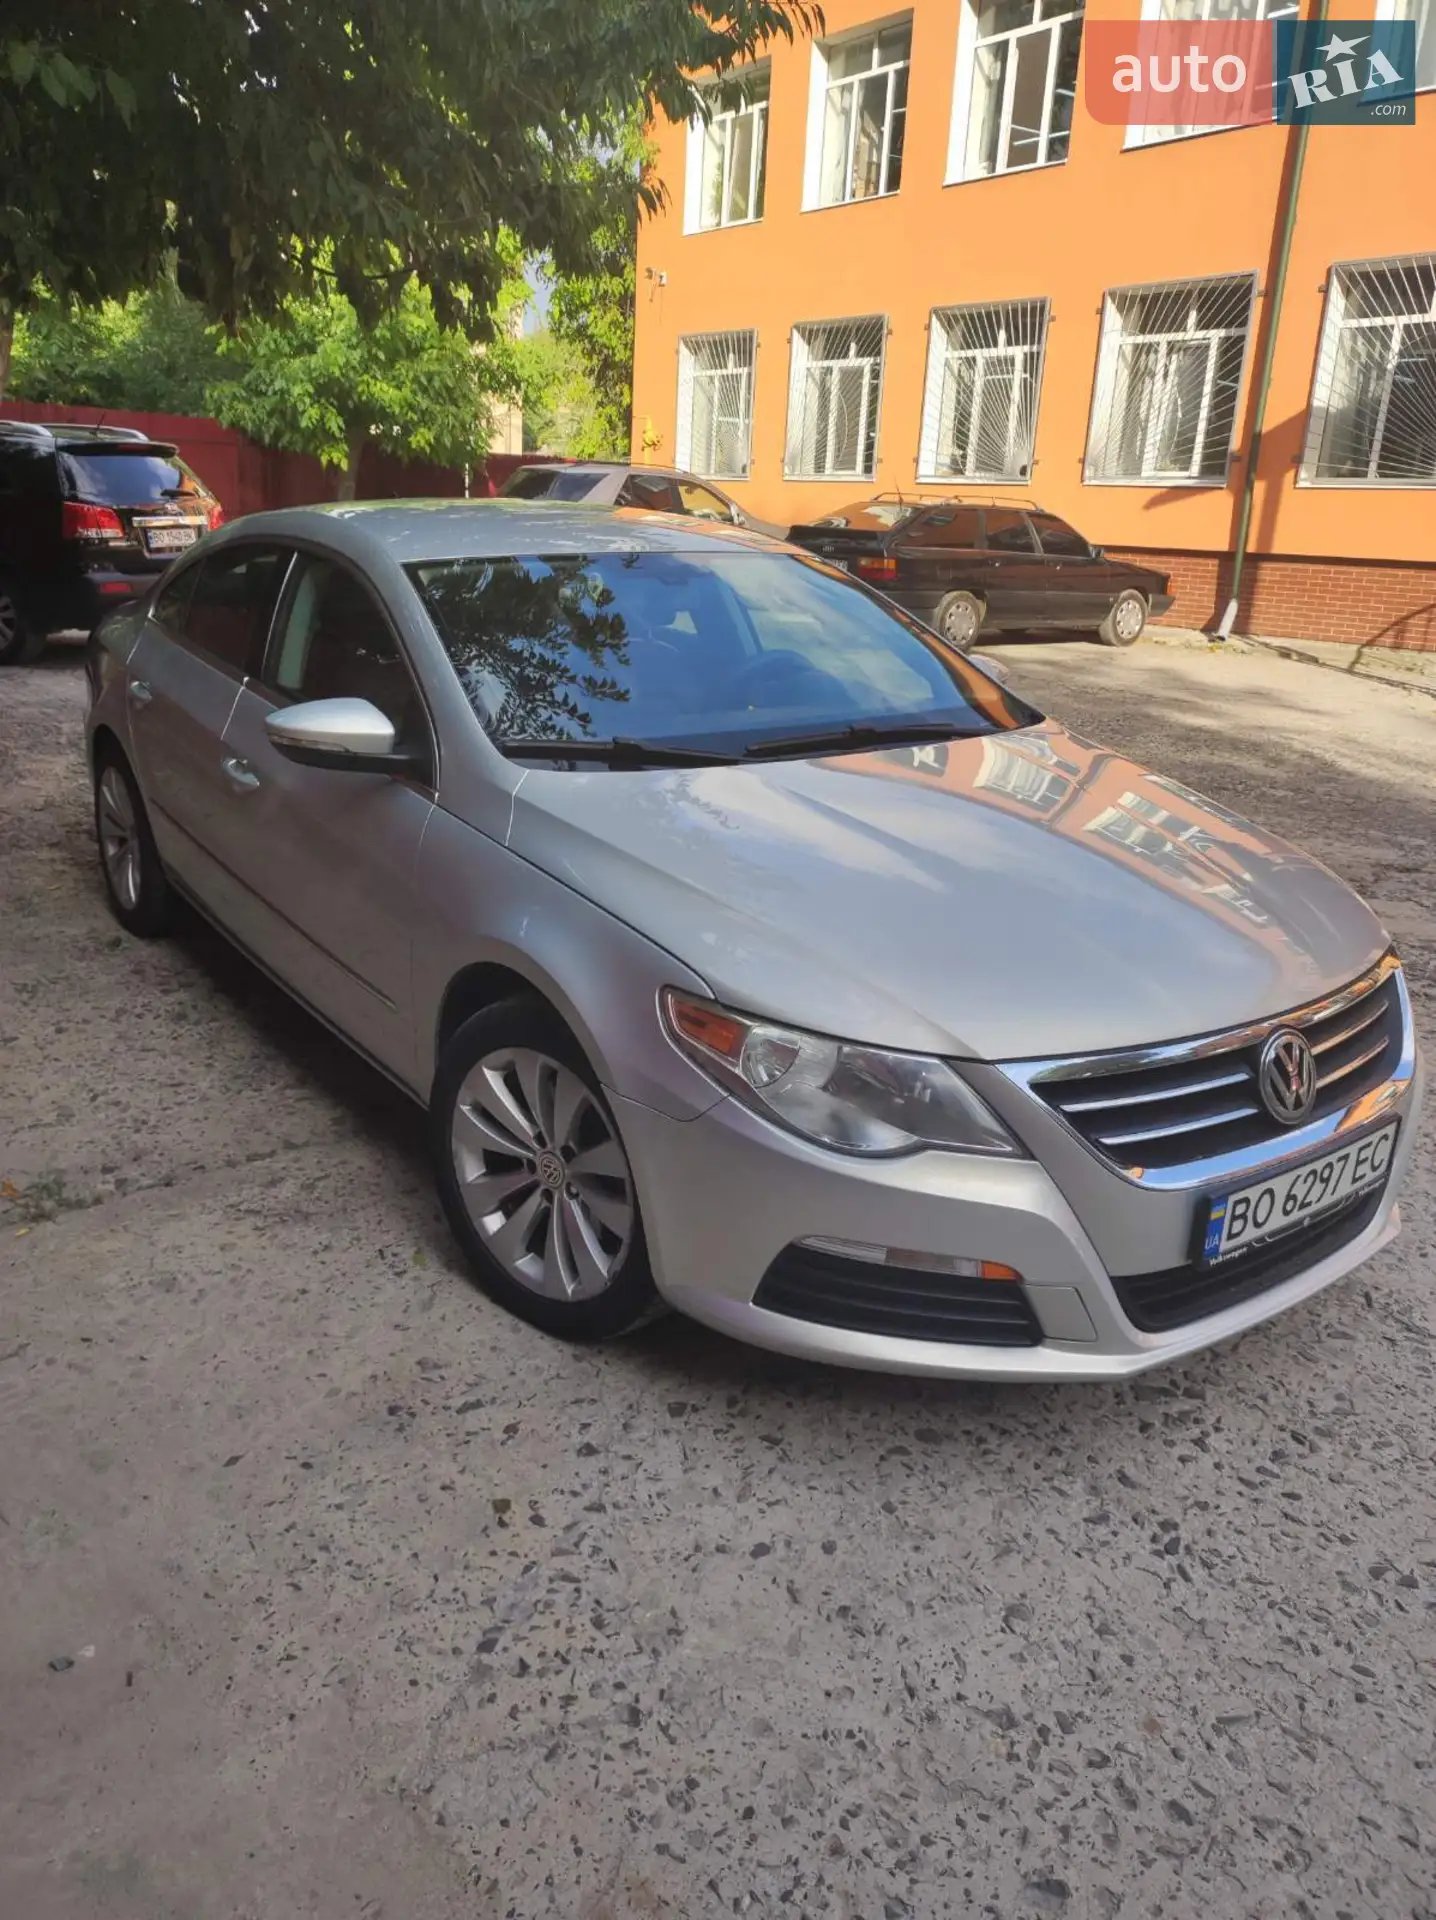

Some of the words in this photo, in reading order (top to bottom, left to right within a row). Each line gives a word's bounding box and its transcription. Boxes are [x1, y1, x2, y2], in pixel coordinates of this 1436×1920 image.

[1226, 1187, 1276, 1242] BO
[1282, 1152, 1351, 1217] 6297
[1351, 1133, 1389, 1185] EC
[1205, 1234, 1219, 1250] UA
